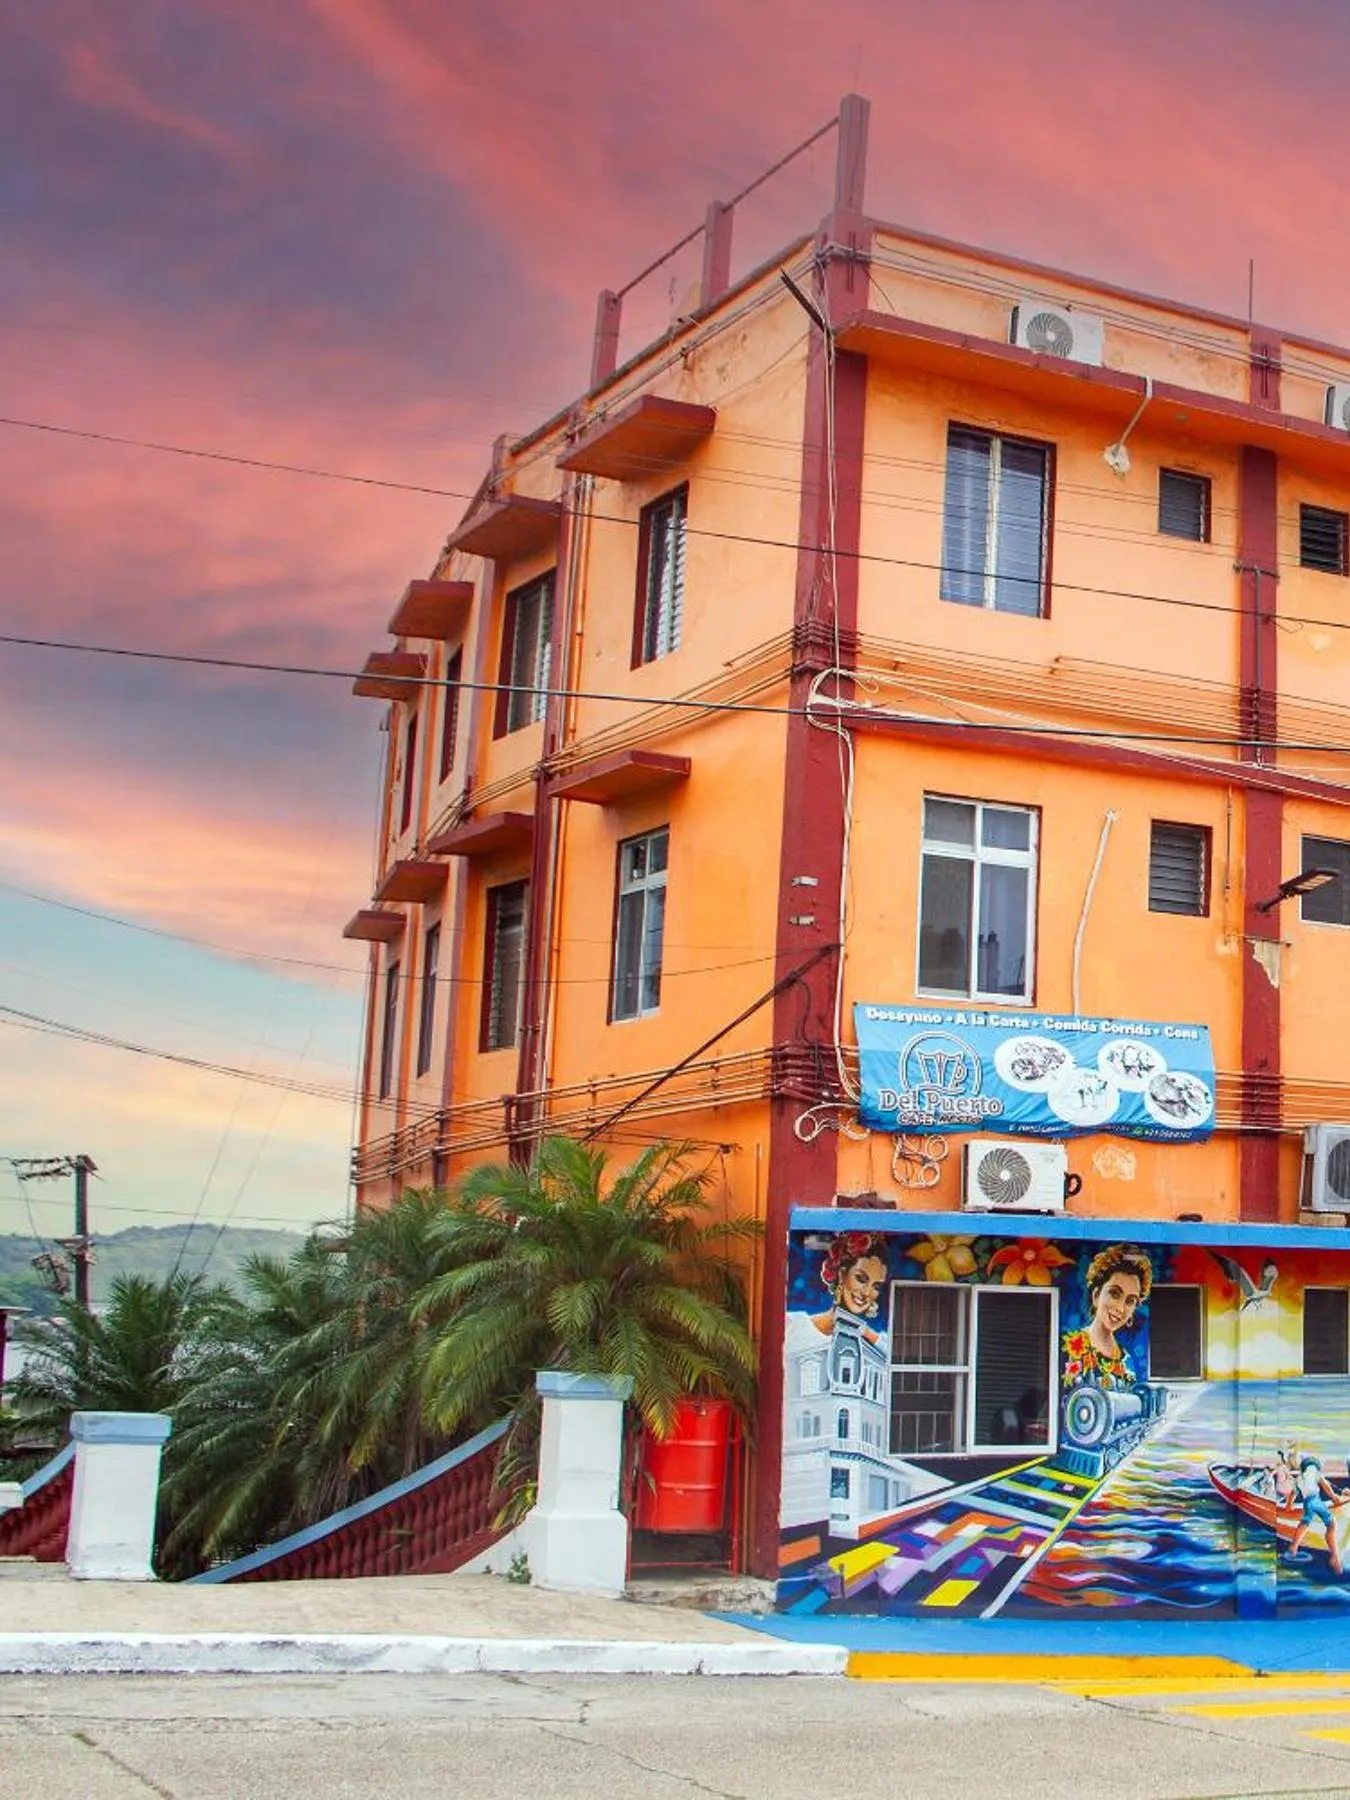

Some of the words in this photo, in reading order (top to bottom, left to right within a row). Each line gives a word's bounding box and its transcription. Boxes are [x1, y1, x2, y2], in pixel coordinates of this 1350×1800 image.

[865, 1007, 943, 1025] Desayuno
[955, 1013, 968, 1026] A
[971, 1014, 986, 1026] la
[1043, 1017, 1097, 1034] Comida
[1101, 1021, 1152, 1037] Corrida
[878, 1088, 918, 1112] Del
[926, 1089, 1004, 1116] Puerto
